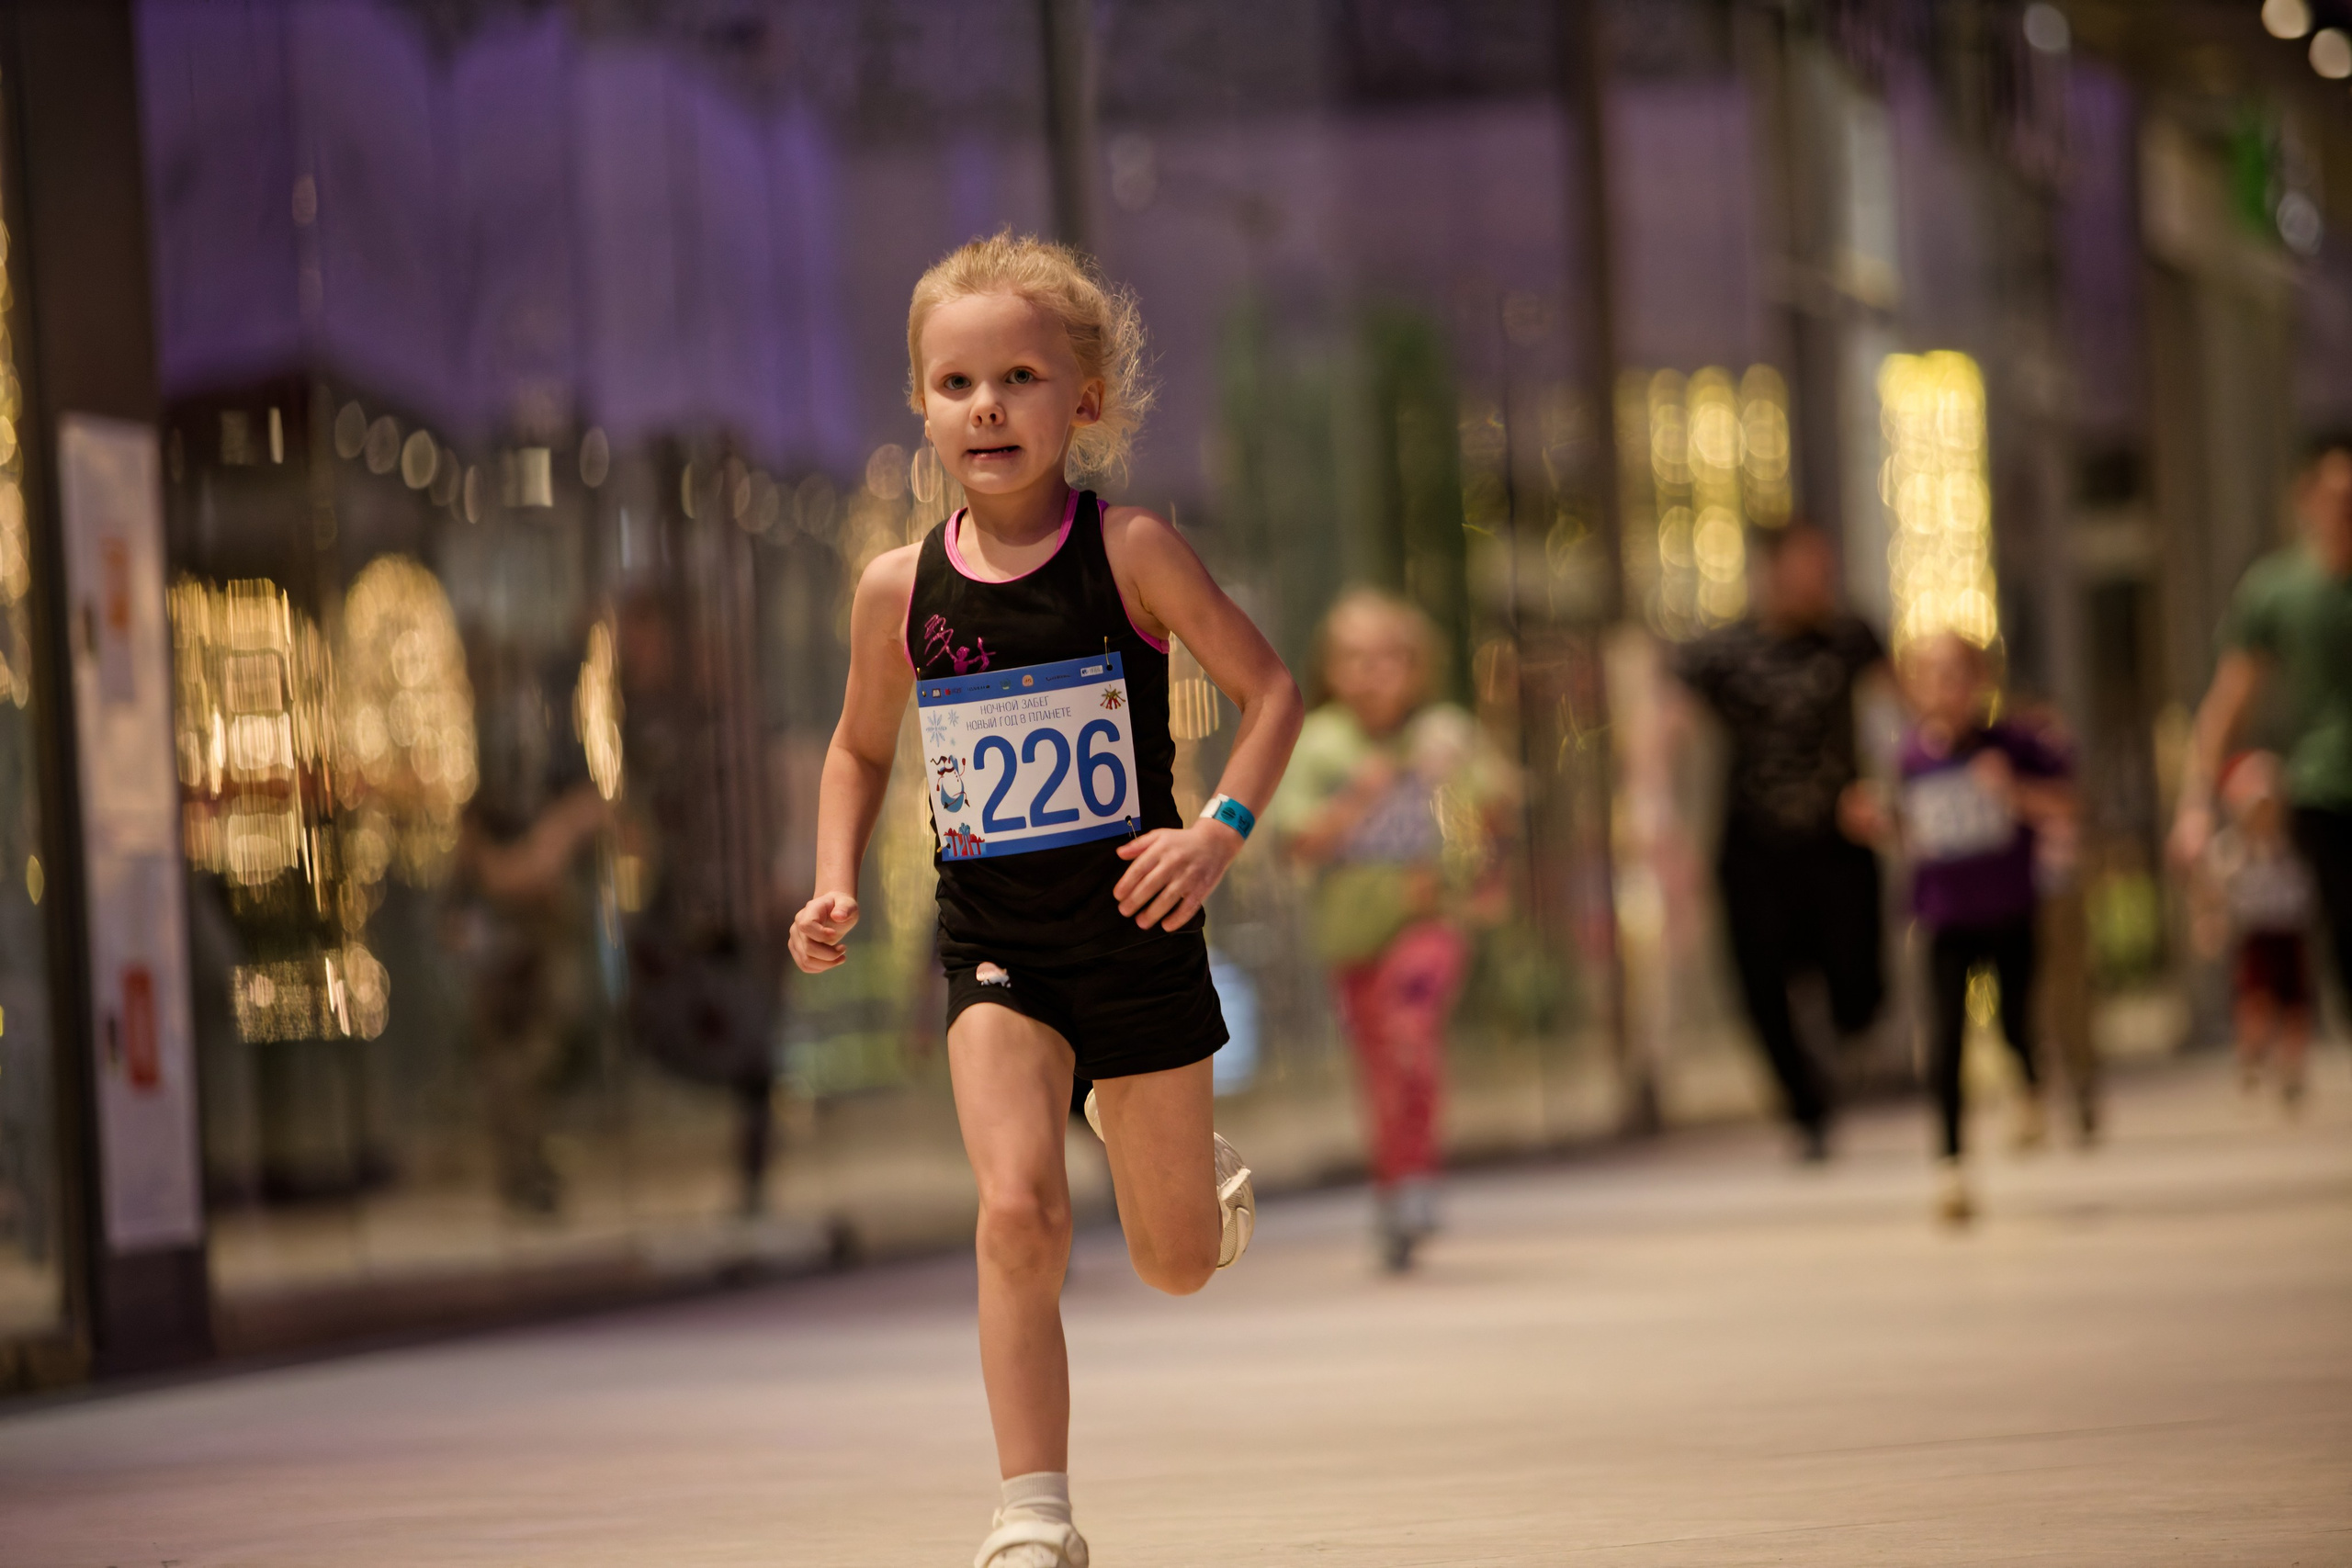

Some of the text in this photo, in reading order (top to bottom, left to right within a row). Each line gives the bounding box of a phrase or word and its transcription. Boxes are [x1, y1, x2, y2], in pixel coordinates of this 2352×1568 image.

[980, 695, 1049, 715] НОЧНОЙ ЗАБЕГ
[967, 706, 1071, 730] НОВЫЙ ГОД В ПЛАНЕТЕ
[973, 718, 1126, 834] 226
